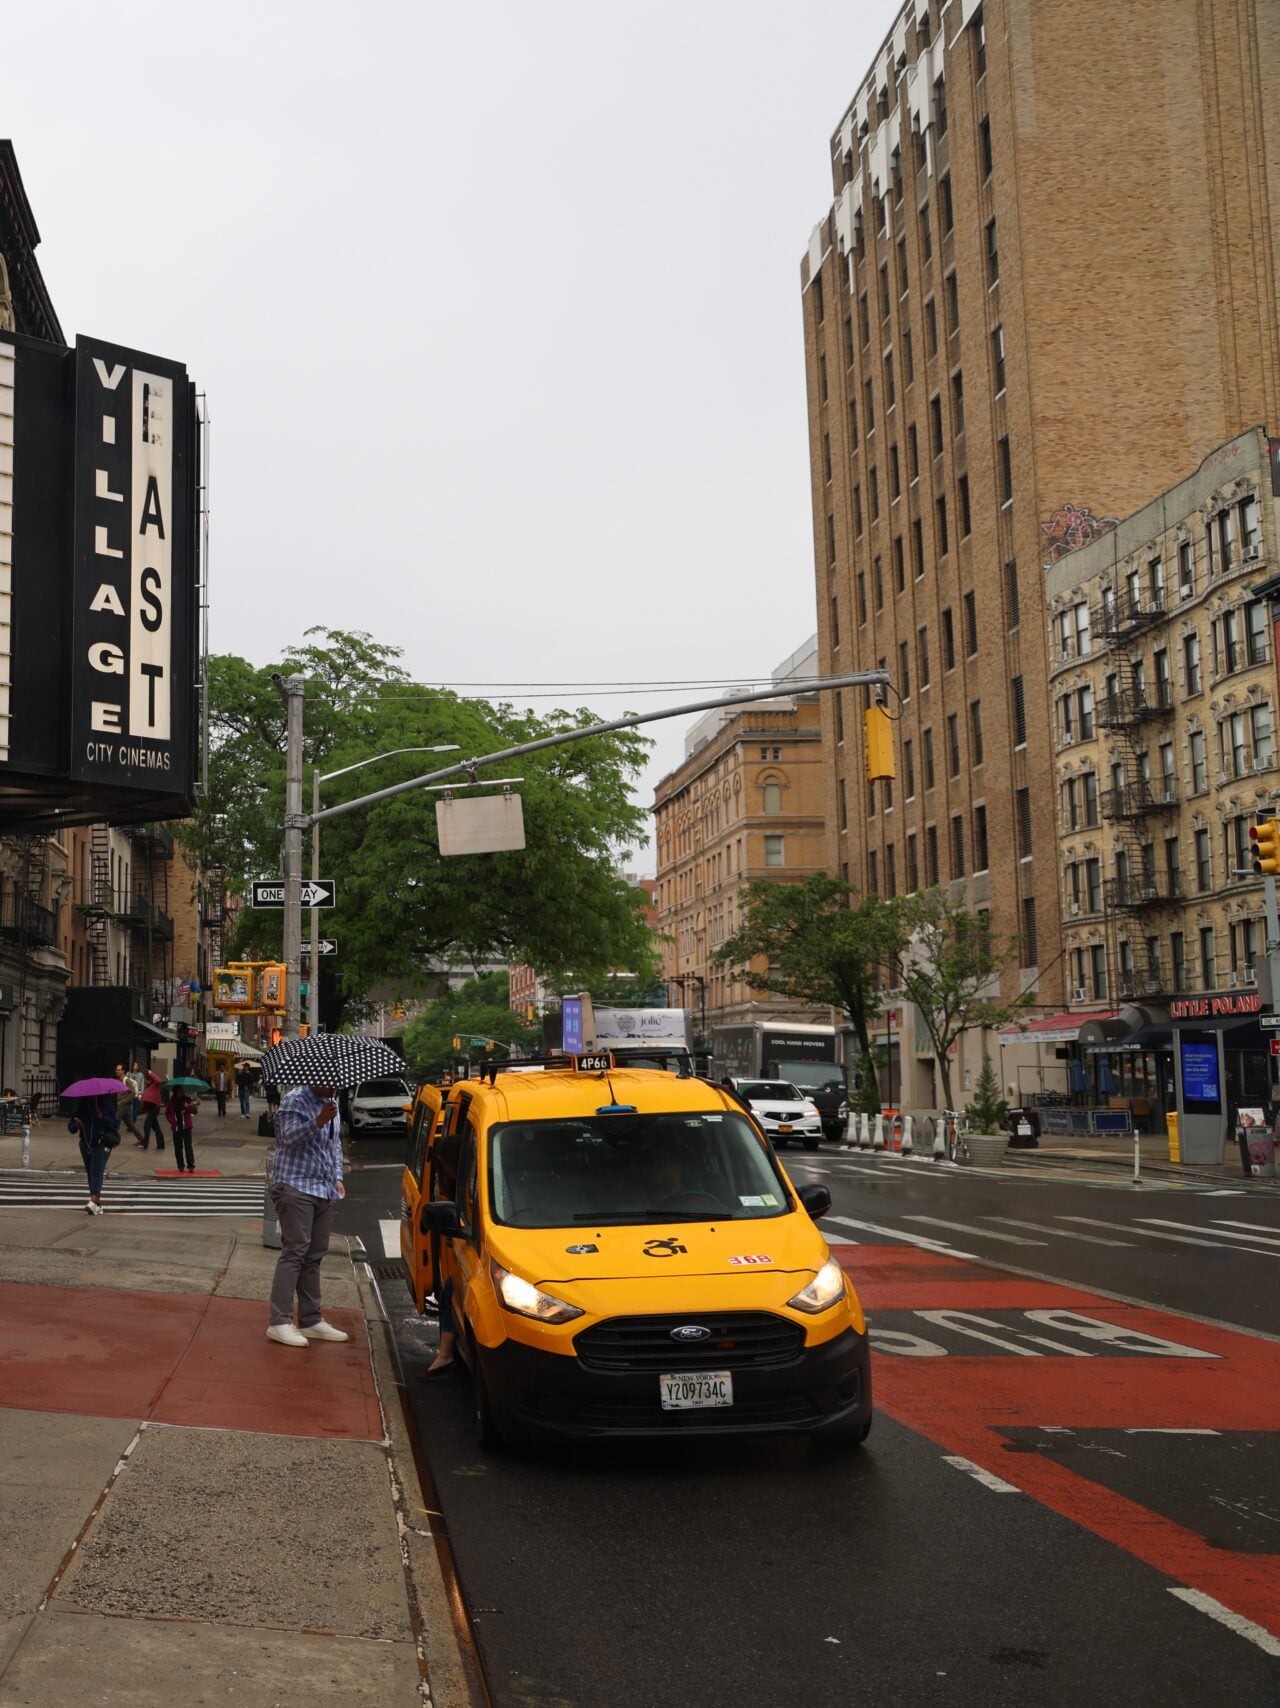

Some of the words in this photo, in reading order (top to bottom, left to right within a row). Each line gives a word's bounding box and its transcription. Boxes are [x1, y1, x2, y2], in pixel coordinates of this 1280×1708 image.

[88, 357, 128, 734] VILLAGE
[86, 741, 114, 764] CITY
[119, 746, 171, 771] CINEMAS
[261, 889, 284, 900] ONE
[300, 889, 319, 900] AY
[1170, 998, 1210, 1018] LITTLE
[1211, 993, 1262, 1016] POLAND
[803, 1040, 825, 1048] MOVERS
[580, 1057, 608, 1070] 4P66
[666, 1380, 727, 1401] Y209734C
